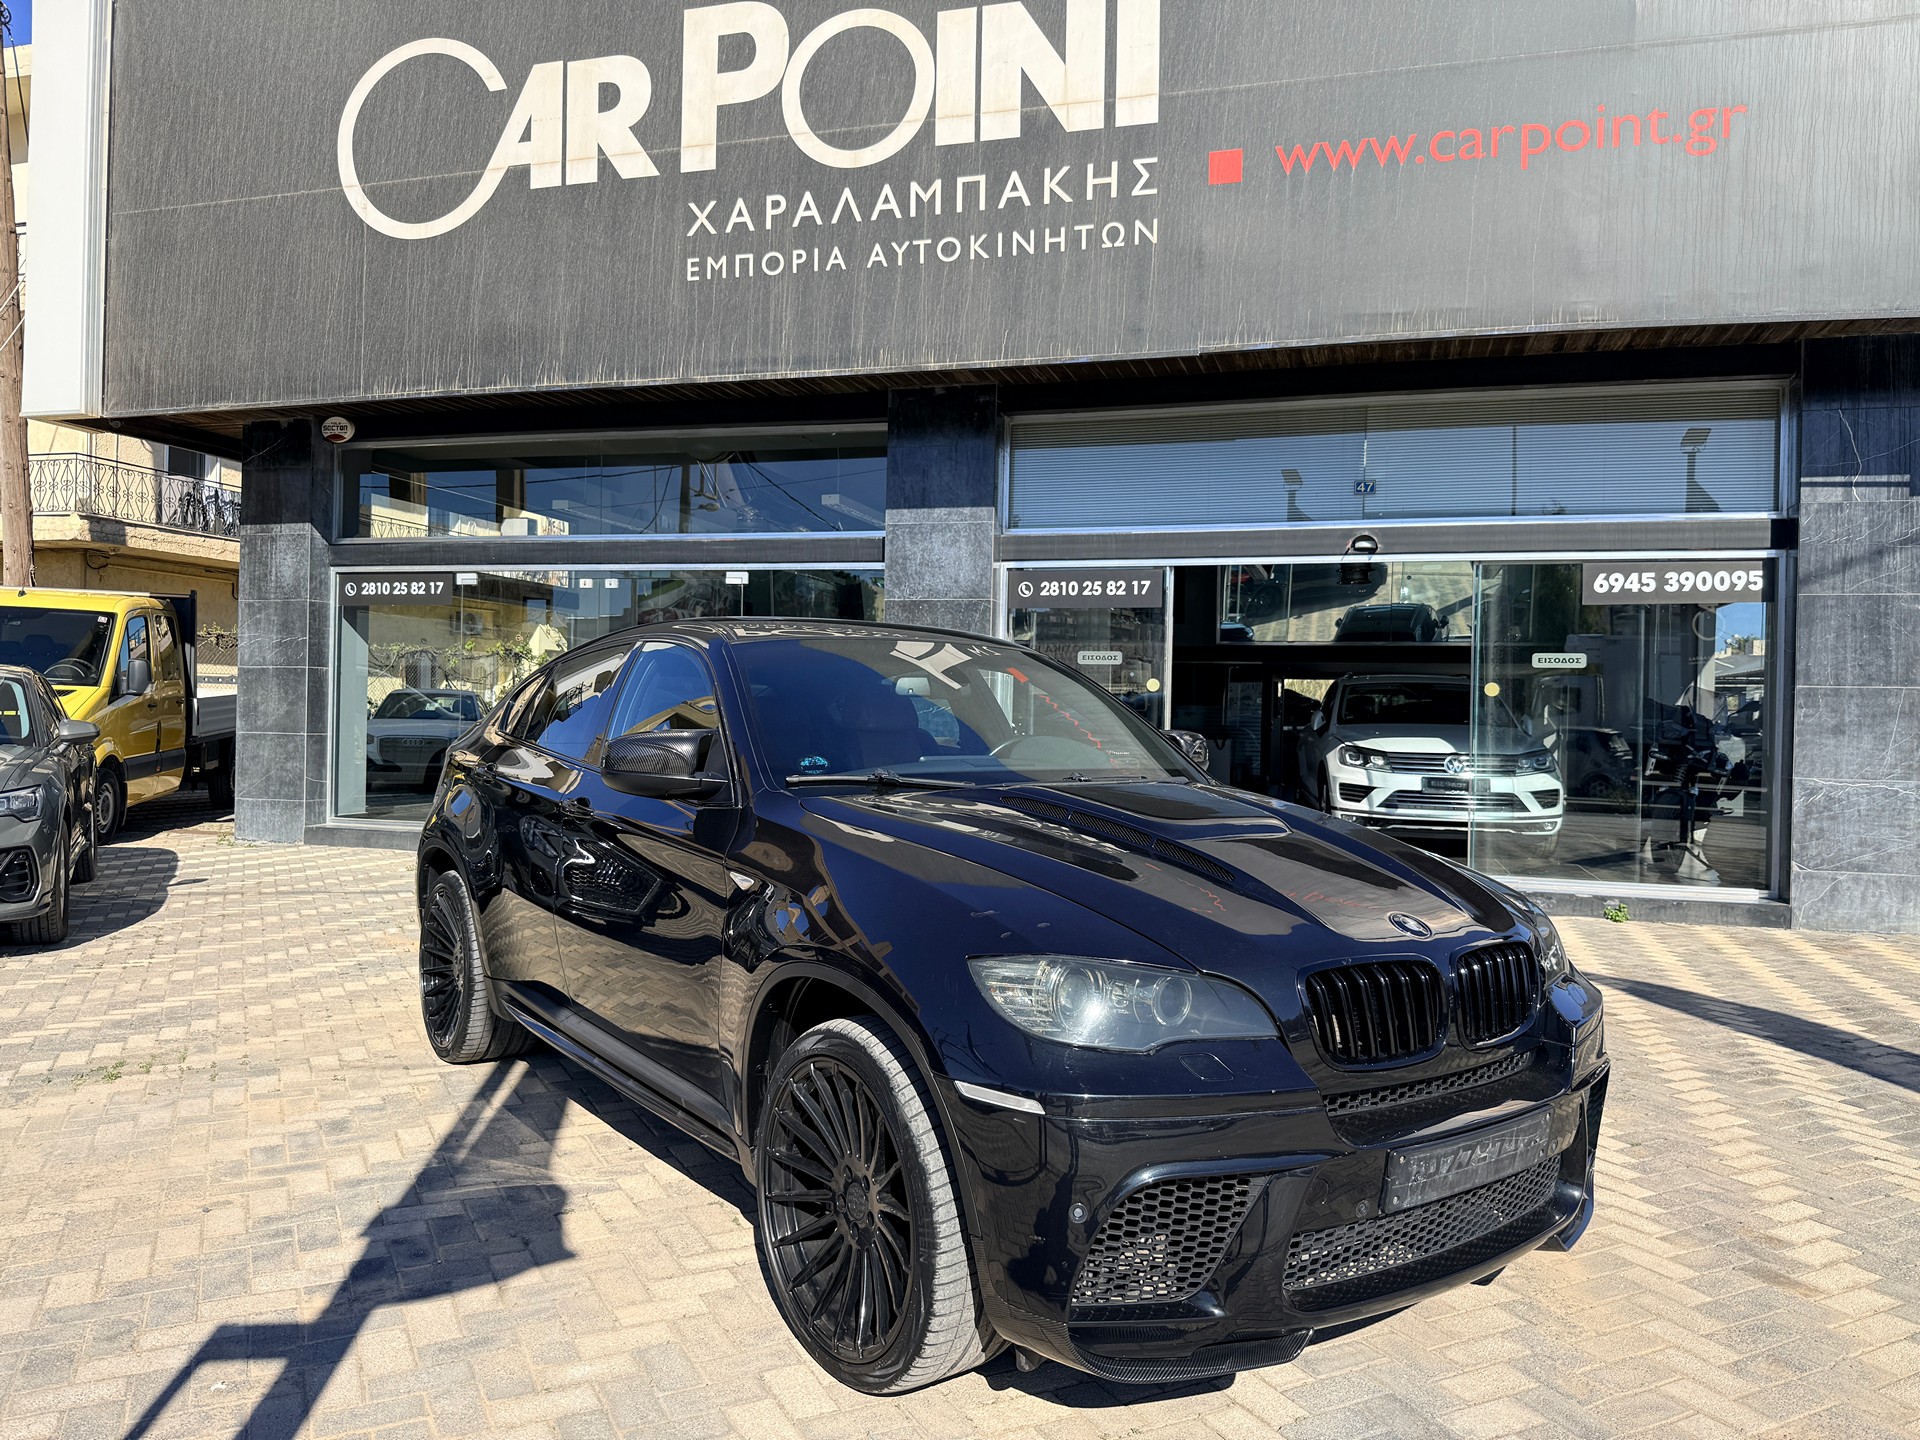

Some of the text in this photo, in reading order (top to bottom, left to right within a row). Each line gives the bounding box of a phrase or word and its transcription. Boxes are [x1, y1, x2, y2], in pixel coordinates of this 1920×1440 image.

[338, 38, 660, 240] CAR
[1275, 103, 1748, 176] www.carpoint.gr
[686, 156, 1159, 237] ΧΑΡΑΛΑΜΠΑΚΗΣ
[686, 218, 1159, 282] ΕΜΠΟΡΙΑ ΑΥΤΟΚΙΝΗΤΩΝ
[1356, 482, 1374, 492] 47
[361, 581, 444, 595] 2810 25 82 17
[1039, 580, 1151, 596] 2810 25 82 17
[1592, 569, 1764, 594] 6945 390095
